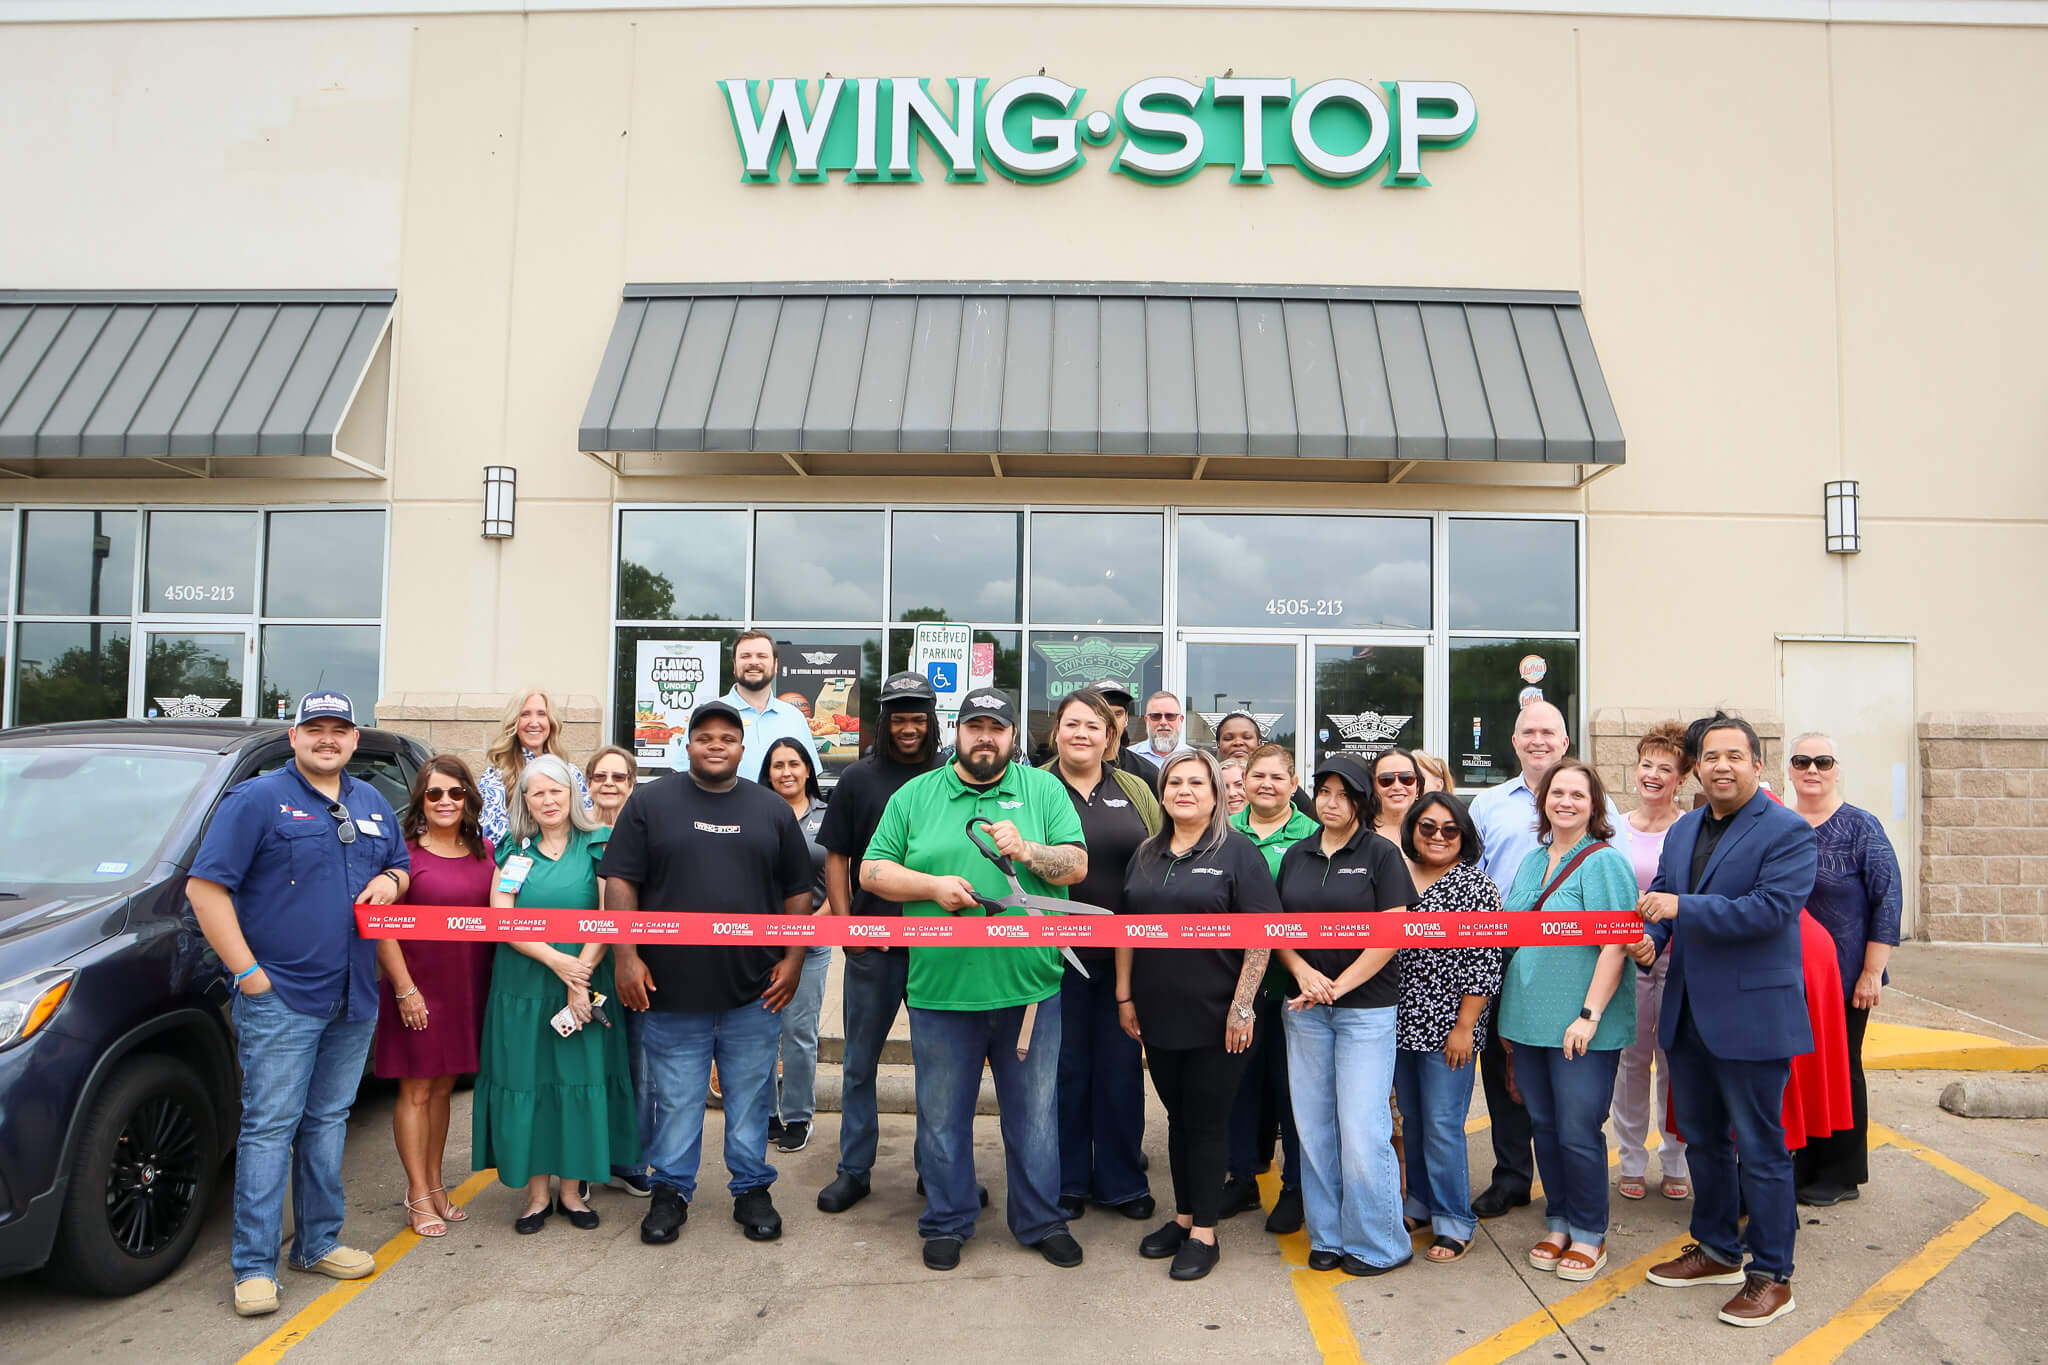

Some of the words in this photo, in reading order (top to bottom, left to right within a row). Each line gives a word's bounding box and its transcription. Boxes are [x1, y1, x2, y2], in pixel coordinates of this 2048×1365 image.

[164, 585, 235, 602] 4505-213
[1264, 600, 1343, 616] 4505-213
[920, 632, 966, 643] RESERVED
[922, 648, 962, 660] PARKING
[656, 658, 700, 670] FLAVOR
[652, 670, 703, 681] COMBOS
[662, 691, 692, 708] $10
[447, 917, 465, 929] 100
[578, 920, 597, 932] 100
[712, 923, 731, 934] 100
[1541, 922, 1560, 935] 100
[848, 925, 868, 936] 100
[986, 926, 1006, 936] 100
[1125, 925, 1145, 936] 100
[1264, 924, 1284, 936] 100
[1403, 923, 1424, 936] 100
